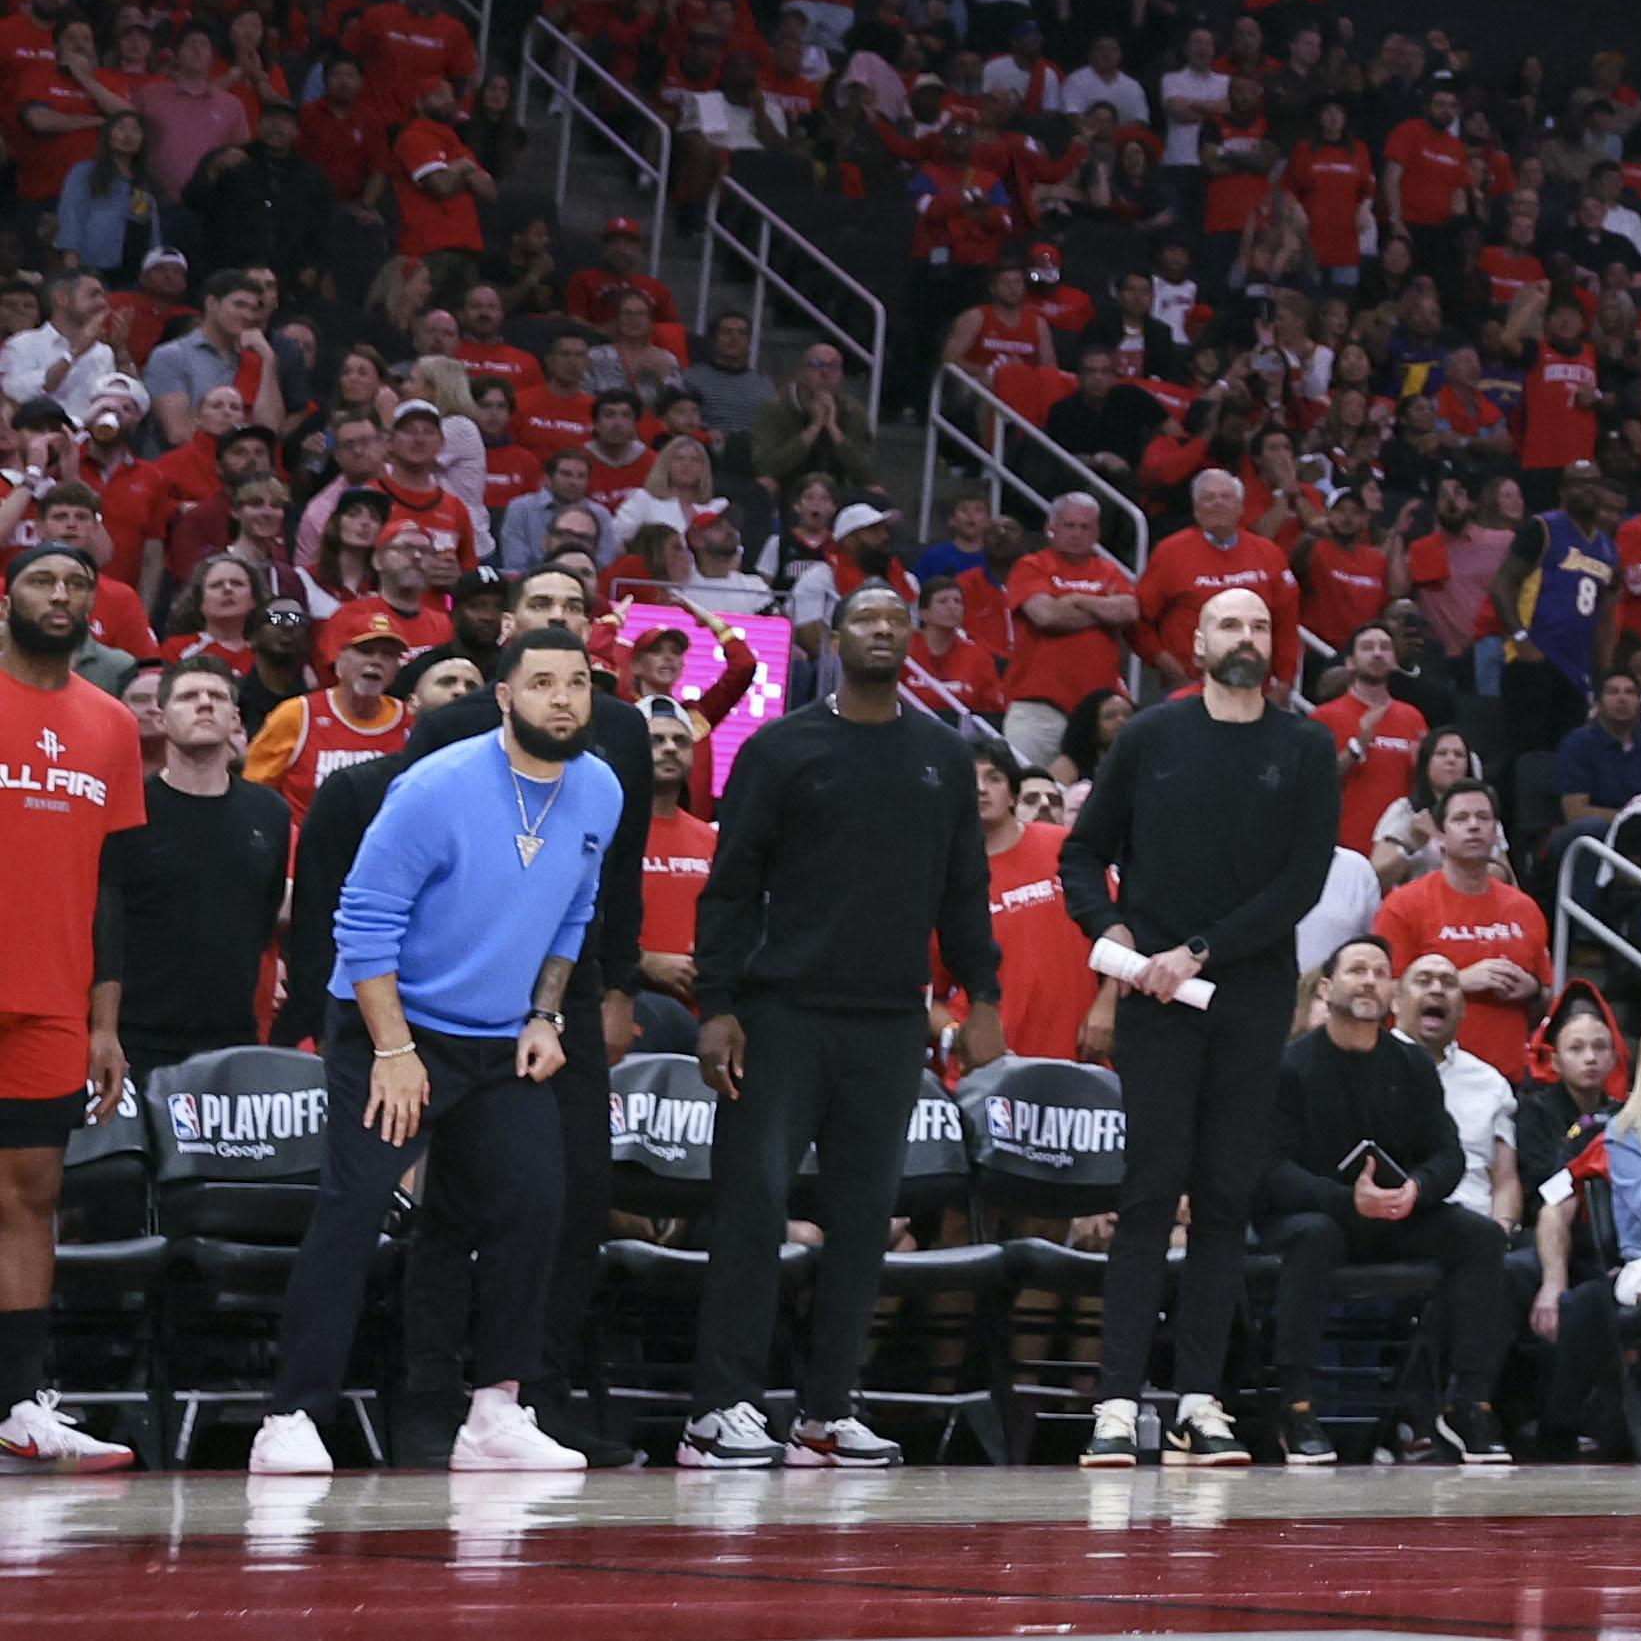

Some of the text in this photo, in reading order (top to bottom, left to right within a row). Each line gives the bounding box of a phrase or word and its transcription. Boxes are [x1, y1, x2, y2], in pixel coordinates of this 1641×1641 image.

[1576, 575, 1598, 617] 8
[0, 764, 42, 792] LL
[46, 766, 107, 807] FIRE
[626, 1091, 718, 1147] PLAYO
